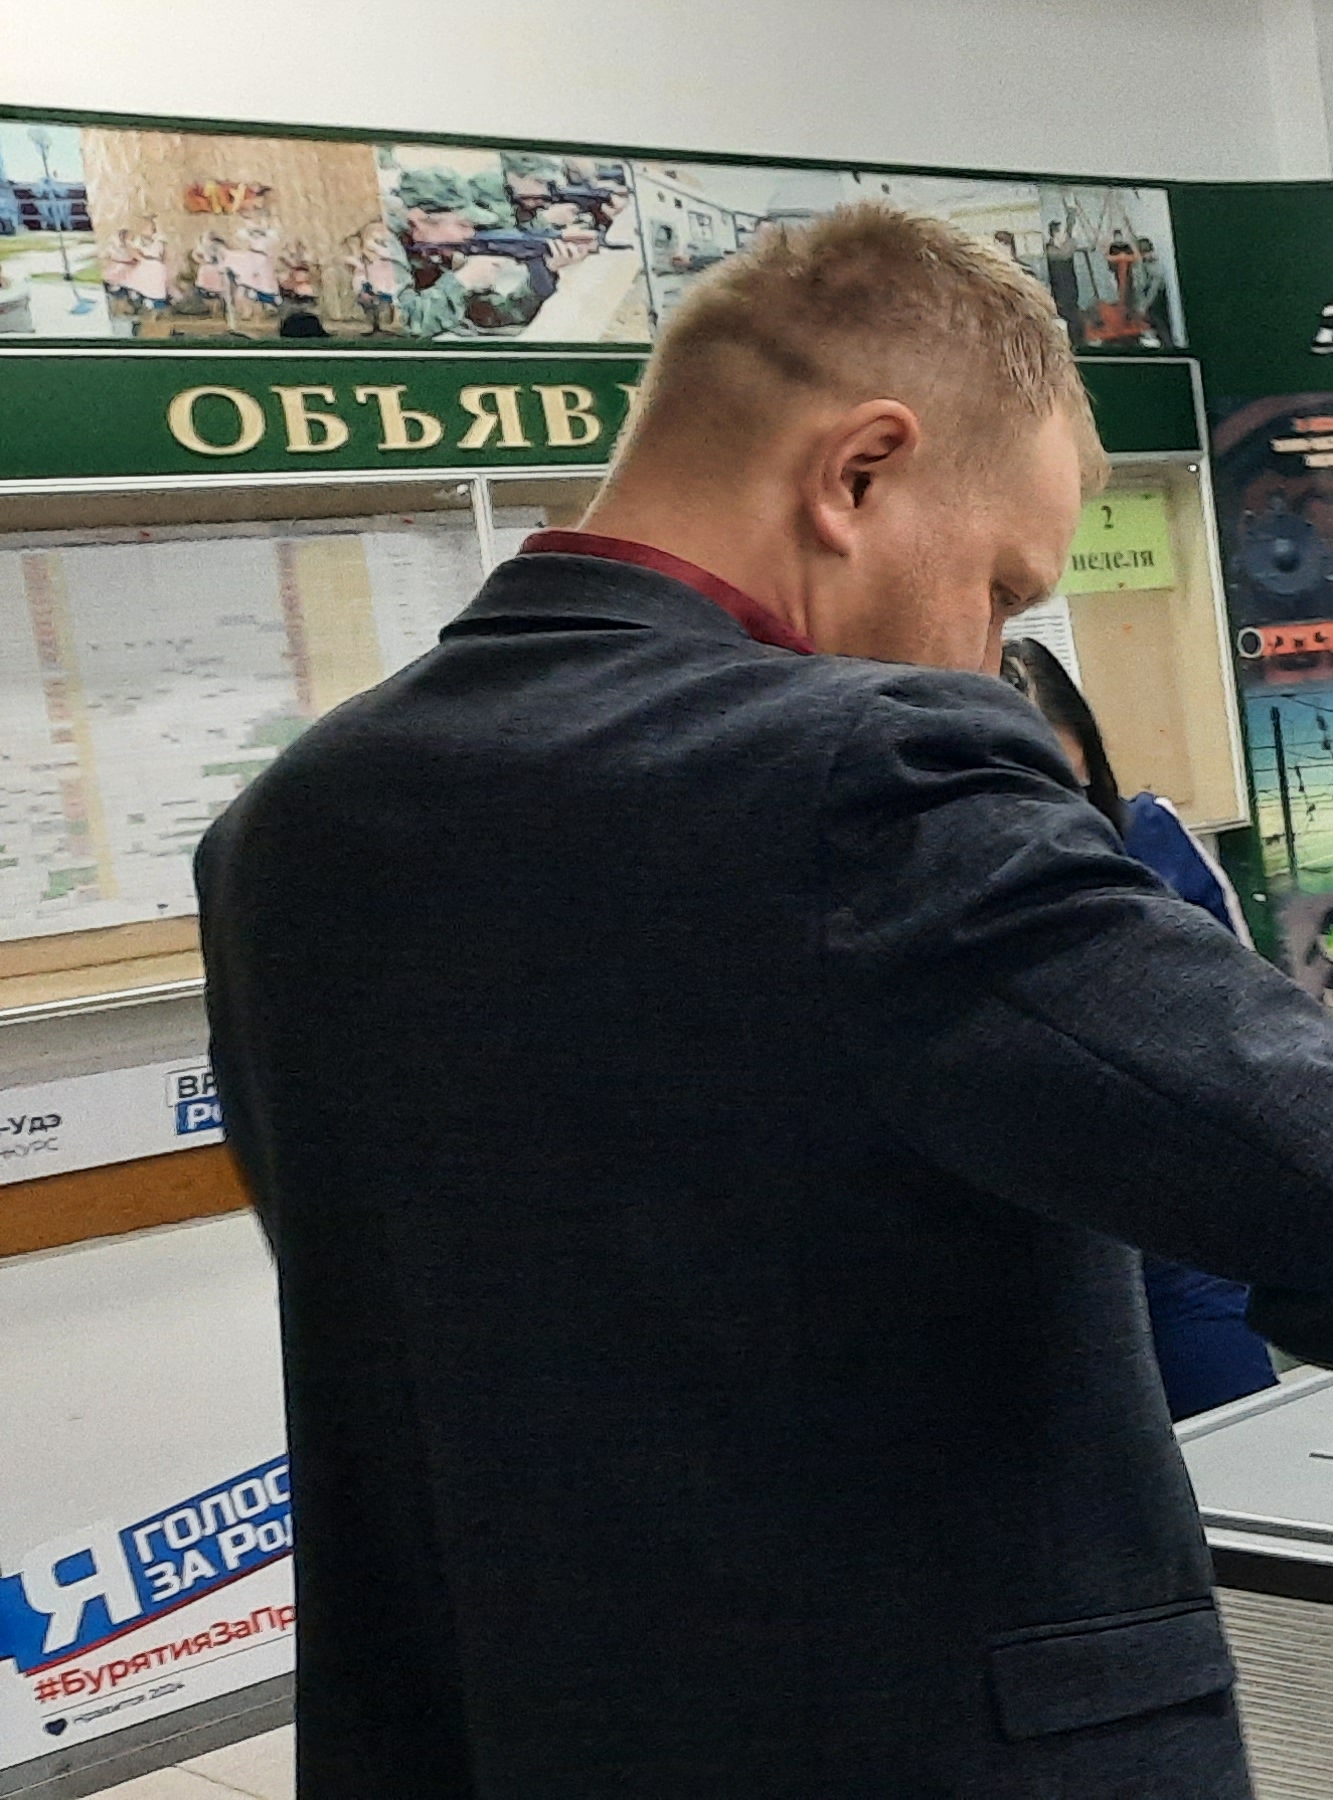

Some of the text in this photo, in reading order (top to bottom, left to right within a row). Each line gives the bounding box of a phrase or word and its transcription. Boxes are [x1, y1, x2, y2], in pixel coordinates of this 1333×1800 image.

[166, 382, 644, 456] ОБЪЯВ
[1101, 505, 1114, 529] 2
[132, 1464, 290, 1564] ГОЛОС
[20, 1531, 144, 1655] Я
[145, 1548, 220, 1602] ЗА
